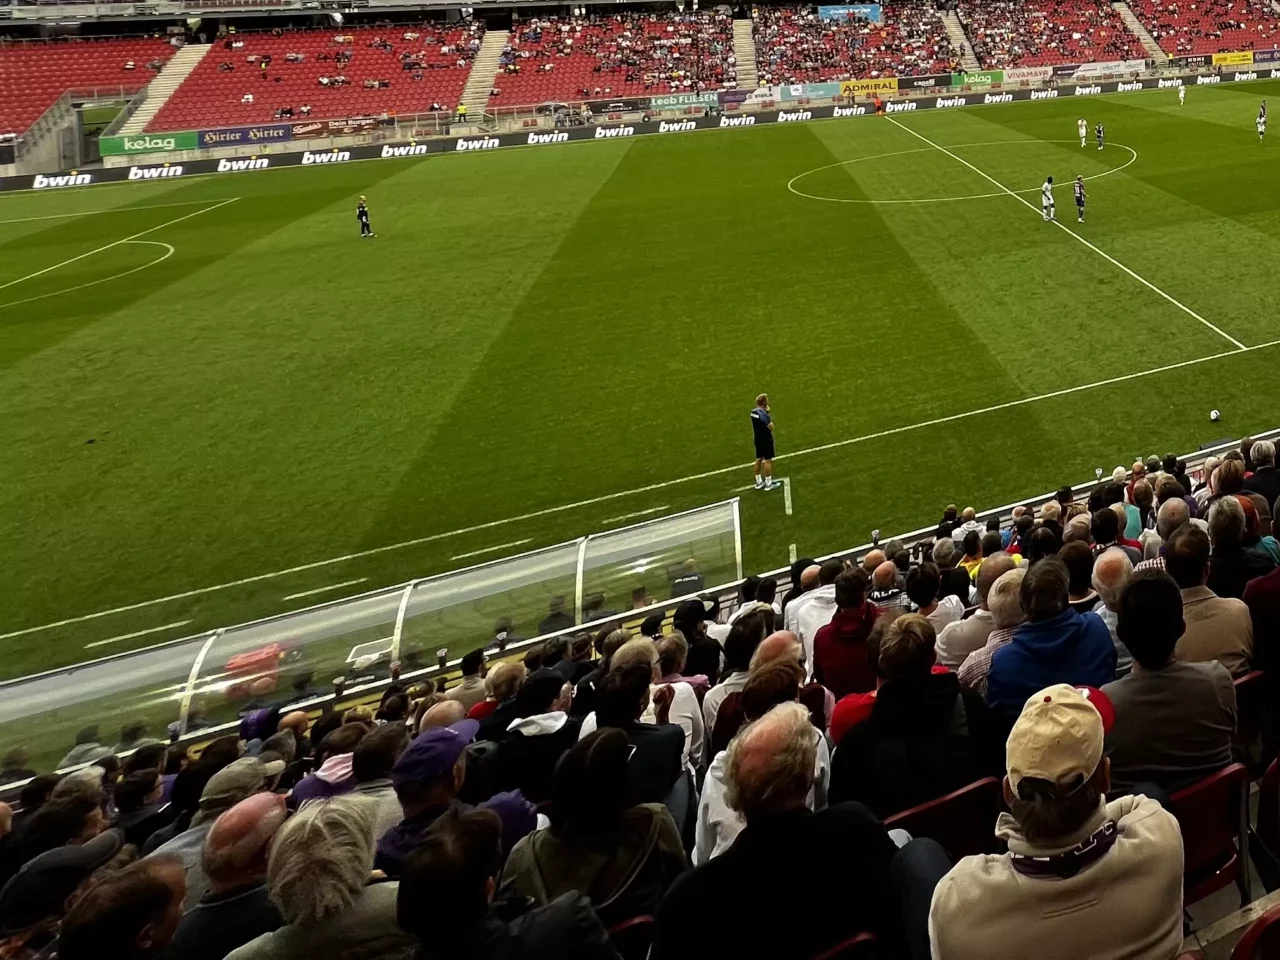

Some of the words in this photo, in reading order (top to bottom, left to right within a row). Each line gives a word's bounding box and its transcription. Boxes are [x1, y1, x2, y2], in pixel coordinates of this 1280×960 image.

[964, 74, 992, 84] kelag
[1006, 70, 1049, 79] VIVAMAYR
[1197, 73, 1220, 84] bwin
[1234, 71, 1257, 82] bwin
[842, 82, 896, 93] ADMIRAL
[1118, 80, 1143, 92] bwin
[1158, 77, 1182, 88] bwin
[1030, 88, 1058, 100] bwin
[1075, 84, 1101, 95] bwin
[651, 96, 677, 105] Leeb
[679, 93, 718, 104] FLIESEN
[936, 96, 966, 108] bwin
[984, 92, 1013, 104] bwin
[833, 105, 866, 117] bwin
[886, 101, 916, 112] bwin
[720, 114, 756, 127] bwin
[778, 110, 812, 122] bwin
[595, 124, 634, 138] bwin
[659, 119, 696, 133] bwin
[204, 132, 242, 144] Hirter
[248, 128, 284, 140] Hirter
[528, 130, 568, 144] bwin
[124, 138, 176, 150] kelag
[456, 136, 500, 150] bwin
[381, 142, 427, 158] bwin
[301, 149, 350, 165] bwin
[217, 155, 269, 172] bwin
[128, 163, 183, 180] bwin
[32, 170, 92, 189] bwin
